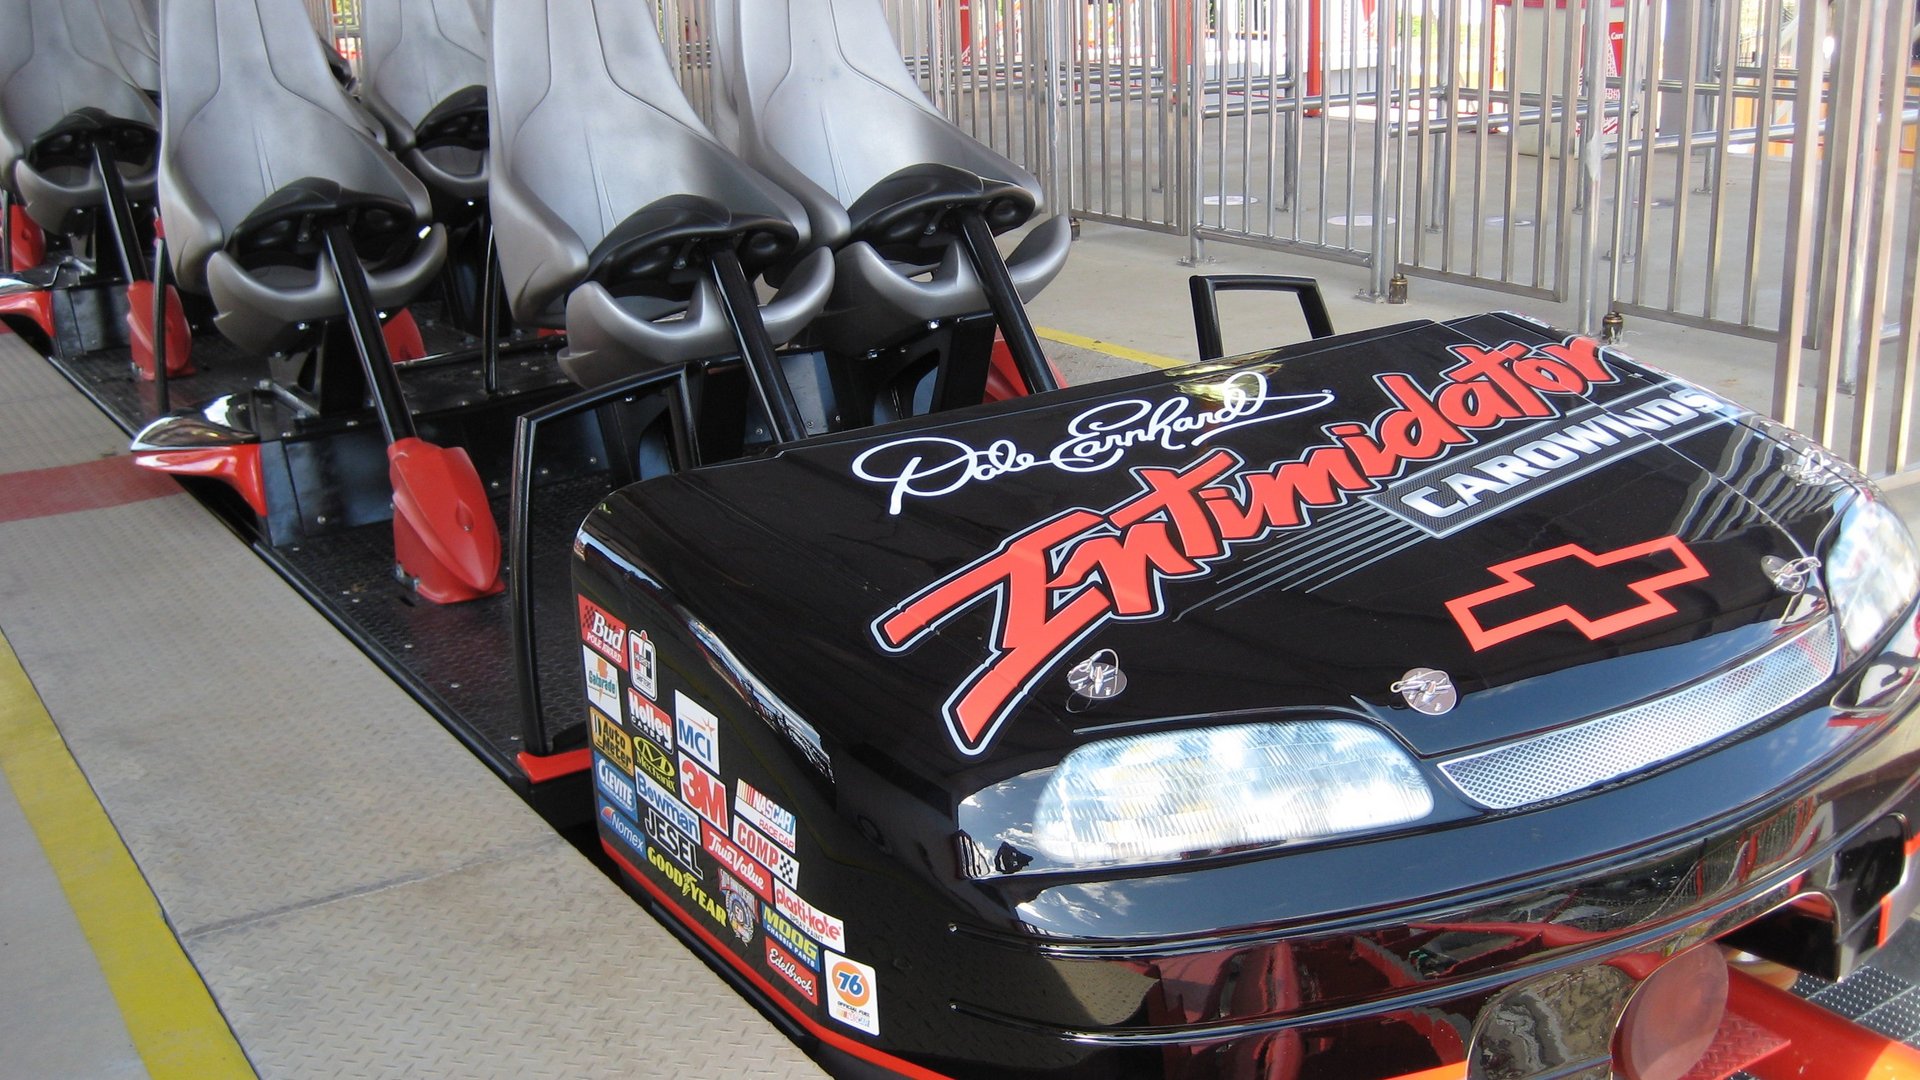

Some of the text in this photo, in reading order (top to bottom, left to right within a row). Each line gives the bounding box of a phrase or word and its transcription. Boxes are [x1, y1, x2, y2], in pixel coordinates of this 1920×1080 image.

[852, 437, 1034, 514] Dale
[1401, 389, 1724, 517] CAROWINDS
[592, 611, 625, 651] Bud
[603, 720, 626, 750] Auto
[627, 690, 673, 750] Holley
[678, 718, 712, 762] MCI
[603, 735, 632, 767] Meter
[599, 759, 633, 806] CLEVITE
[682, 760, 729, 836] 3M
[637, 772, 700, 842] Bowman
[752, 791, 792, 835] NASCAR
[612, 813, 645, 852] Nomex
[645, 807, 704, 880] JESEL
[737, 822, 779, 868] COMP
[759, 819, 795, 851] RACE CAR
[764, 907, 819, 960] MOOG
[768, 947, 814, 997] Edelbrock
[793, 947, 815, 968] PARTS
[838, 971, 863, 996] 76
